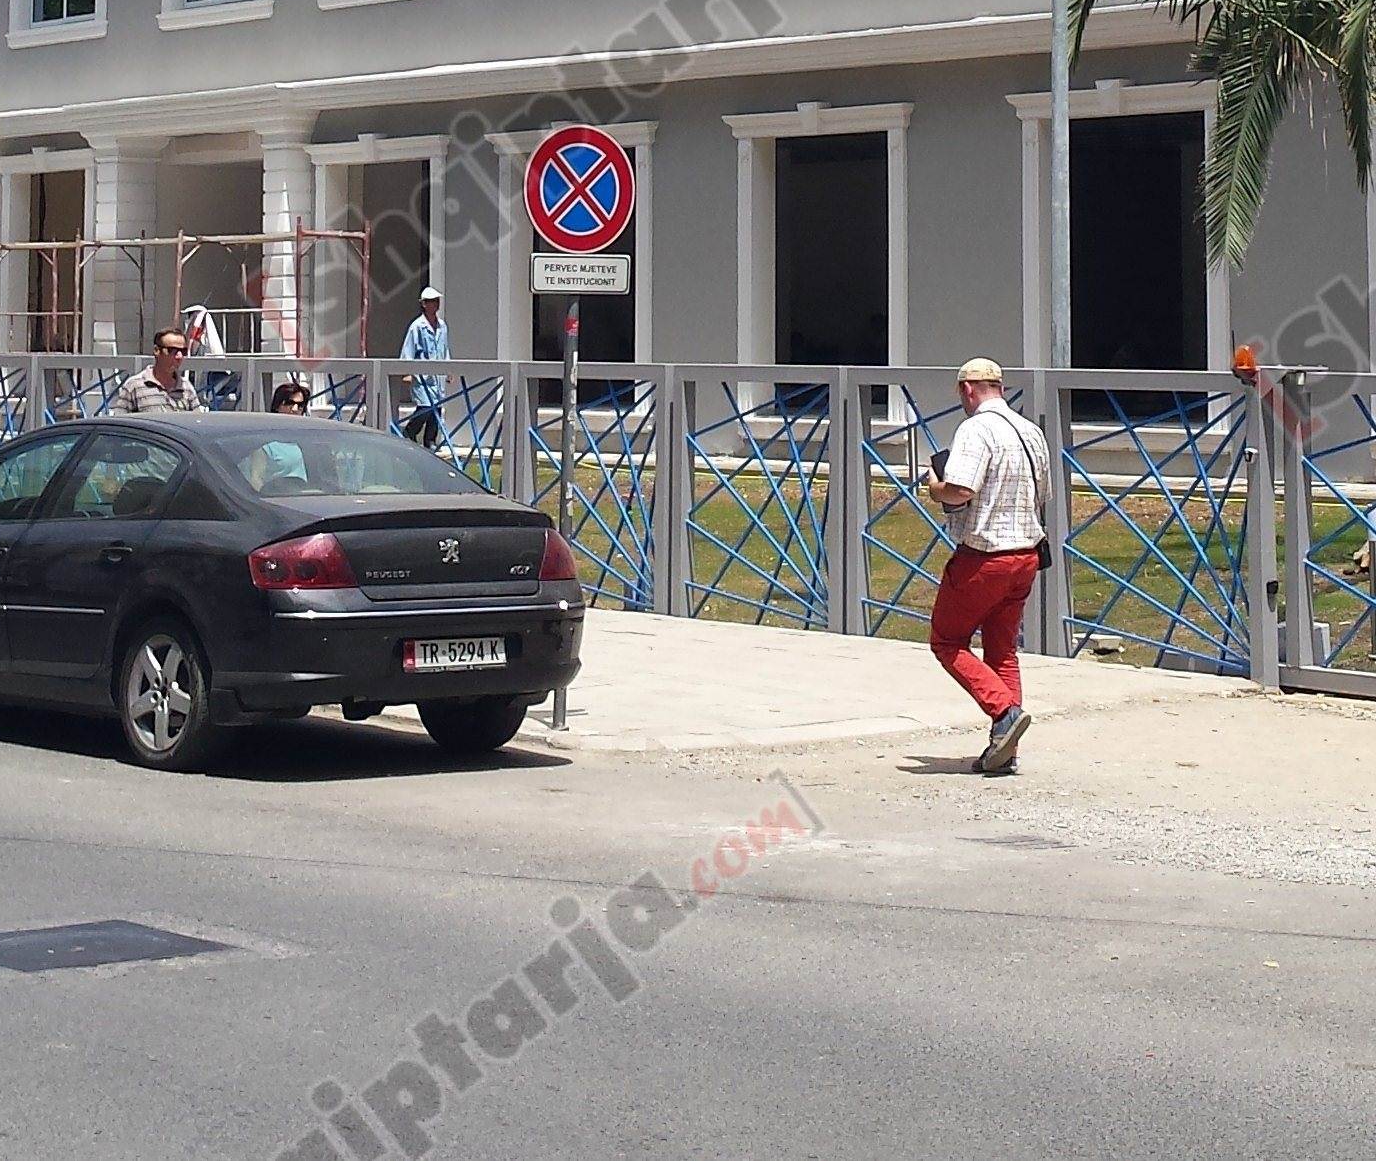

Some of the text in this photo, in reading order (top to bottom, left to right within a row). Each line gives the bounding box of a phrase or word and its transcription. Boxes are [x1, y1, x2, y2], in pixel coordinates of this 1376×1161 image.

[544, 264, 617, 273] PERVEC MJETEVE
[545, 277, 616, 286] TE INSTITUCIONIT
[365, 570, 411, 579] PEUGEOT
[448, 641, 485, 662] 5294
[490, 640, 500, 661] K
